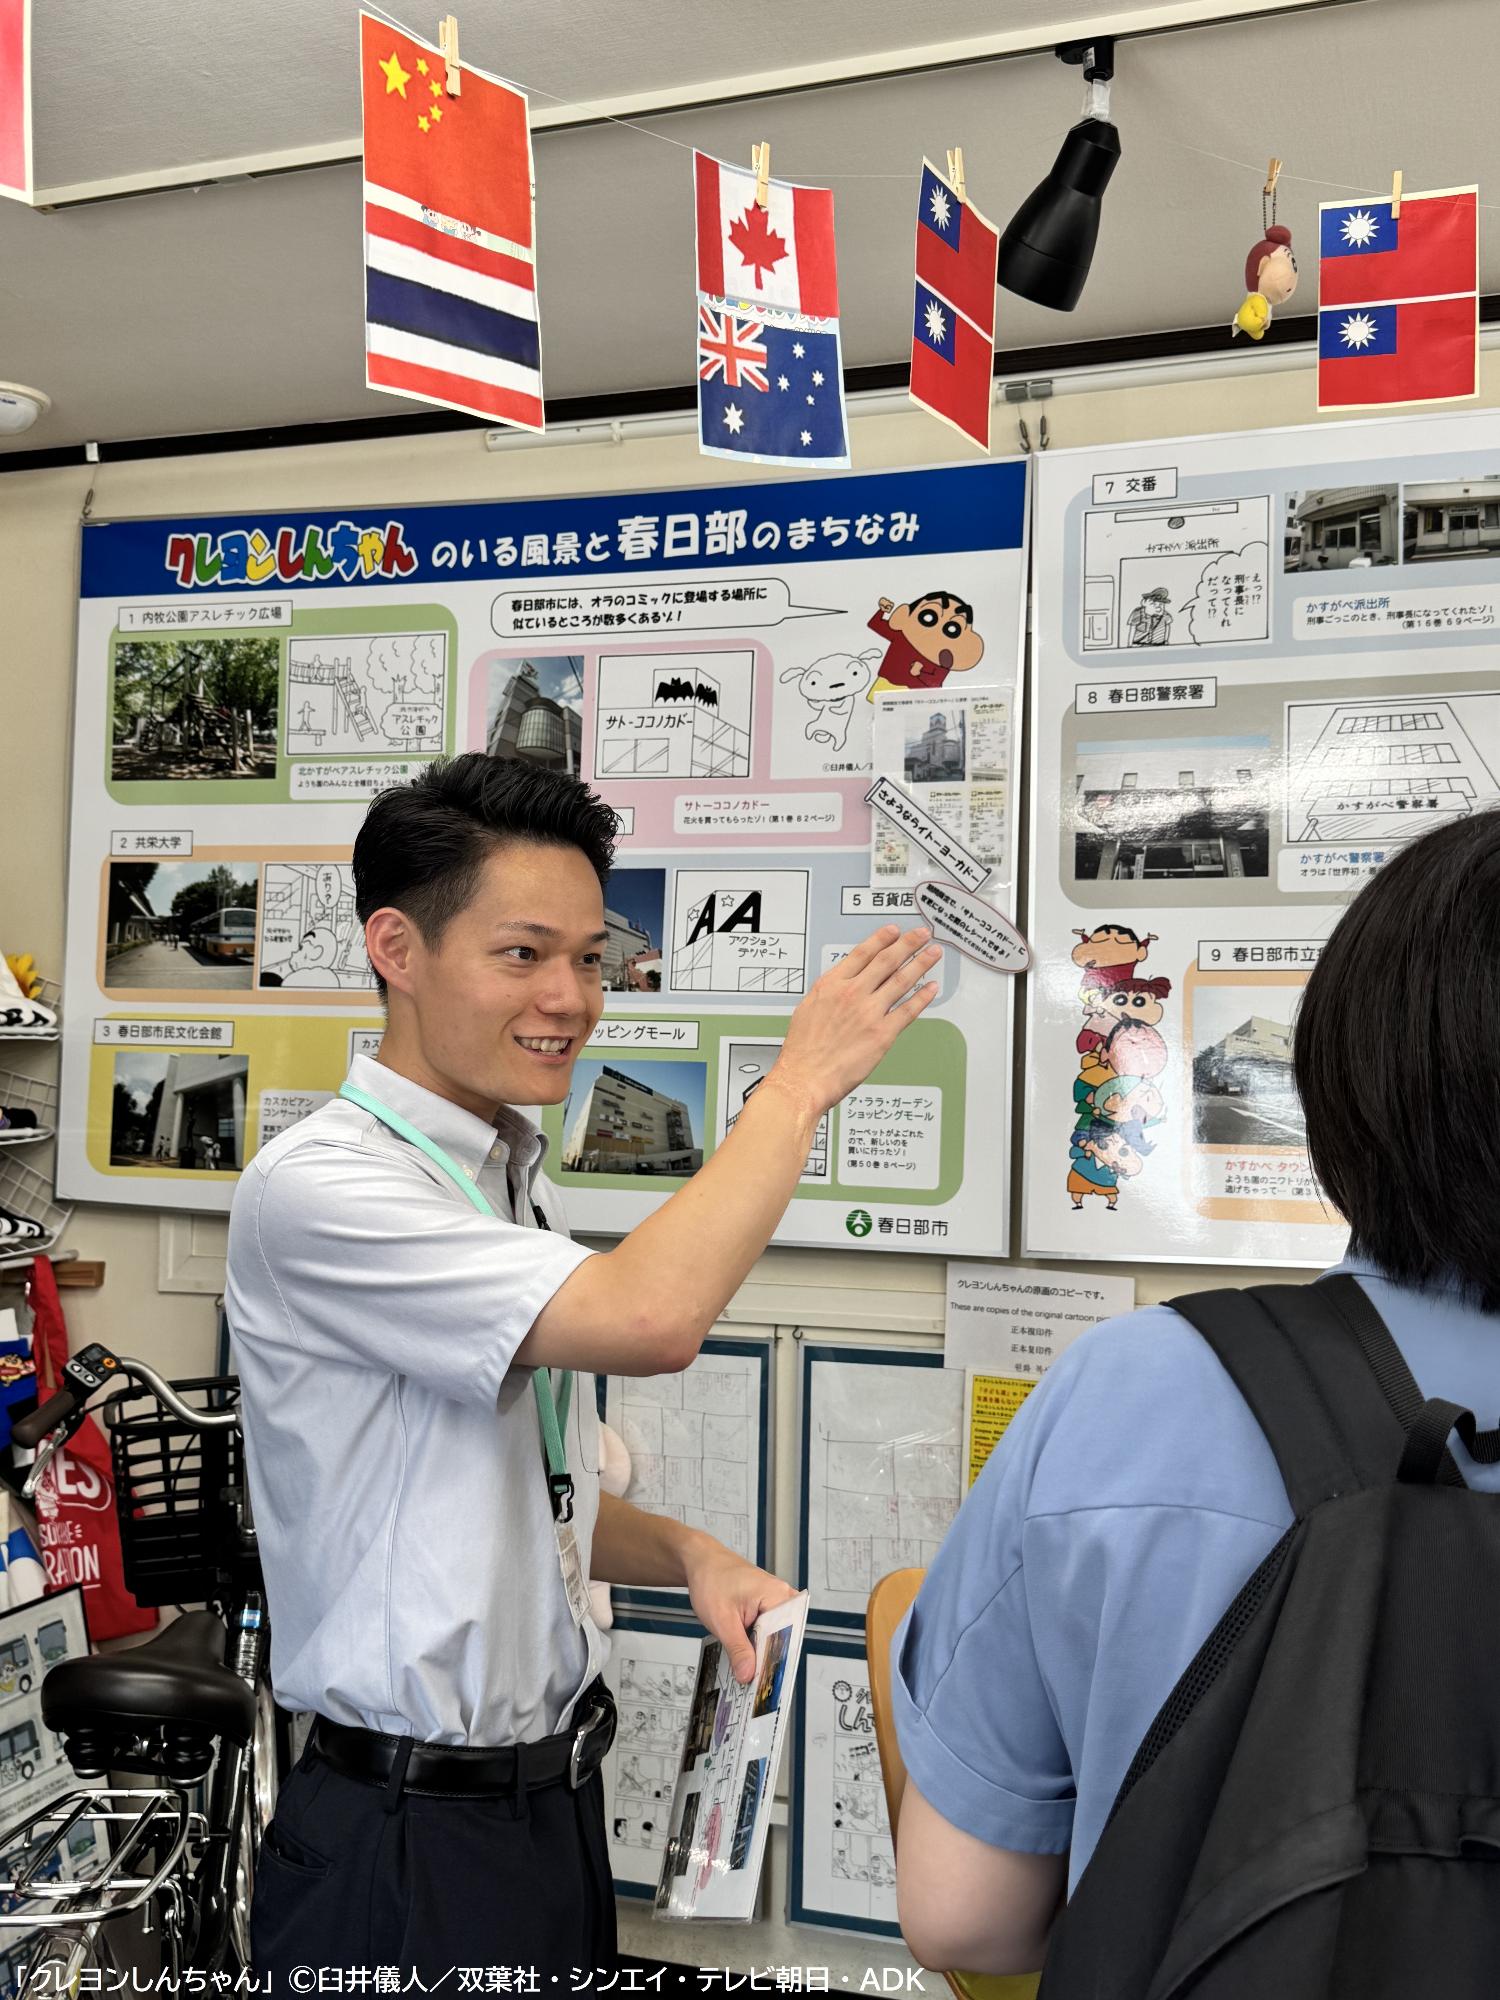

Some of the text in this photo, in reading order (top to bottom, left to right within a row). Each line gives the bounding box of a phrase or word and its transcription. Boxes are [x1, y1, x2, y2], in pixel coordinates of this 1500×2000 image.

[1105, 478, 1157, 494] 7 交番
[165, 521, 419, 588] クレヨンしんちゃん
[512, 587, 767, 612] 春日部市には、オラのコミックに登場する場所に
[1306, 597, 1390, 614] かすがべ派出所
[129, 606, 283, 625] 1 内牧公園アスレチック広場
[1087, 685, 1204, 704] 8 春日部警察署
[684, 800, 770, 811] サトーココノカドー
[121, 837, 182, 849] 2 共栄大学
[877, 790, 980, 883] さようならイトーヨーカドー
[852, 892, 913, 907] 5 百貨店
[729, 935, 780, 947] アクション
[1211, 949, 1221, 962] 9
[103, 1025, 223, 1040] 3 春日部市民文化会館
[848, 1097, 933, 1109] ア・ララ・ガーデン
[847, 1109, 934, 1121] ショッピングモール
[849, 1128, 924, 1138] カーペットがよごれた
[848, 1137, 908, 1147] ので、新しいのを
[878, 1217, 949, 1236] 春日部市
[957, 1279, 1104, 1300] クレヨンしんちゃんの原画のコピーです。
[950, 1302, 971, 1311] These
[986, 1306, 1009, 1315] copies
[1021, 1308, 1033, 1316] the
[1035, 1310, 1063, 1320] original
[1064, 1313, 1094, 1322] cartoon
